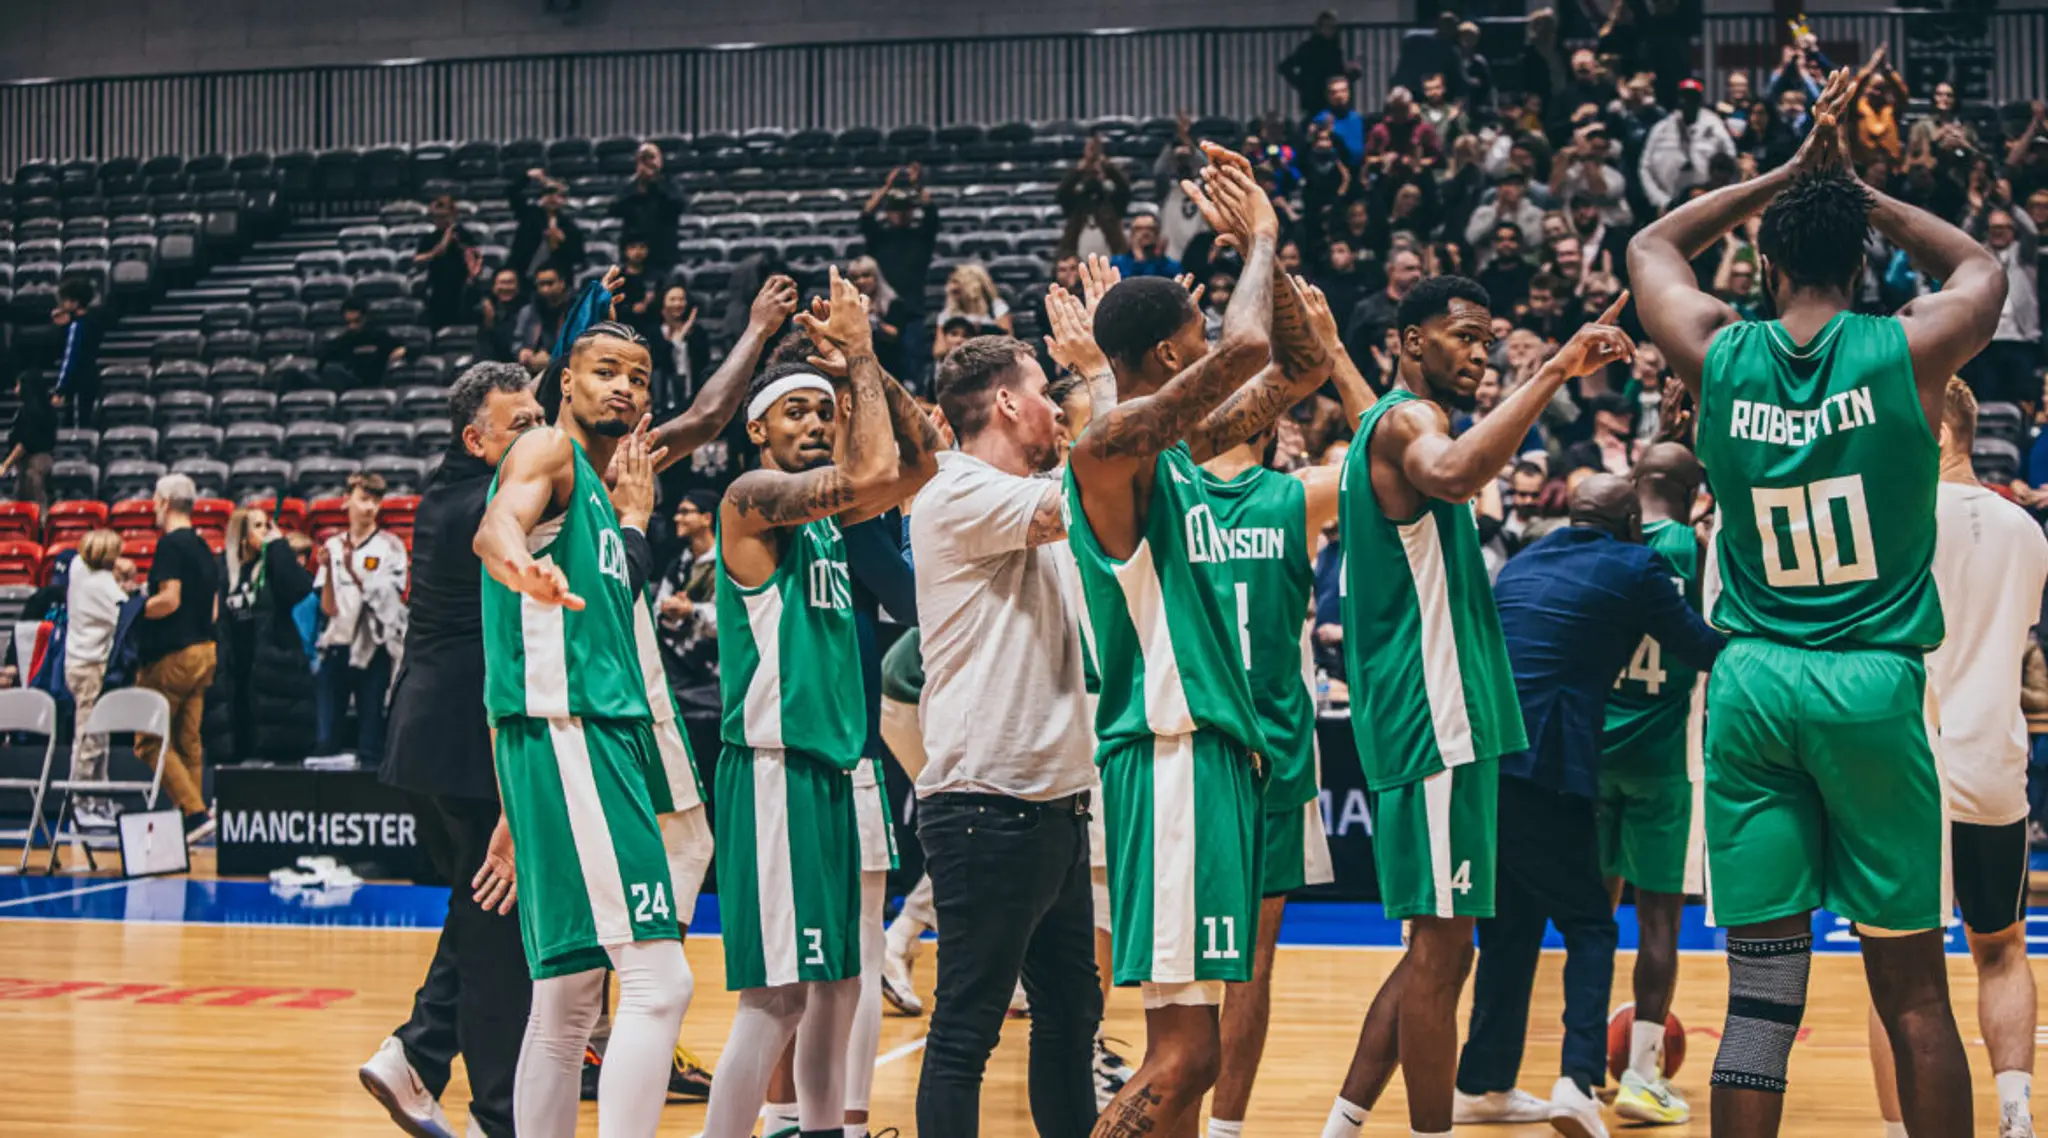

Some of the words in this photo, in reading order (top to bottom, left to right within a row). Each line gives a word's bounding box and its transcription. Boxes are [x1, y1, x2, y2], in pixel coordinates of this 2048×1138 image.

[1730, 386, 1876, 447] ROBERTIN
[1751, 474, 1879, 587] 00
[1612, 632, 1667, 695] 4
[221, 809, 417, 847] MANCHESTER
[1451, 859, 1473, 895] 4
[630, 881, 670, 922] 24
[803, 928, 824, 965] 3
[1202, 916, 1240, 959] 11
